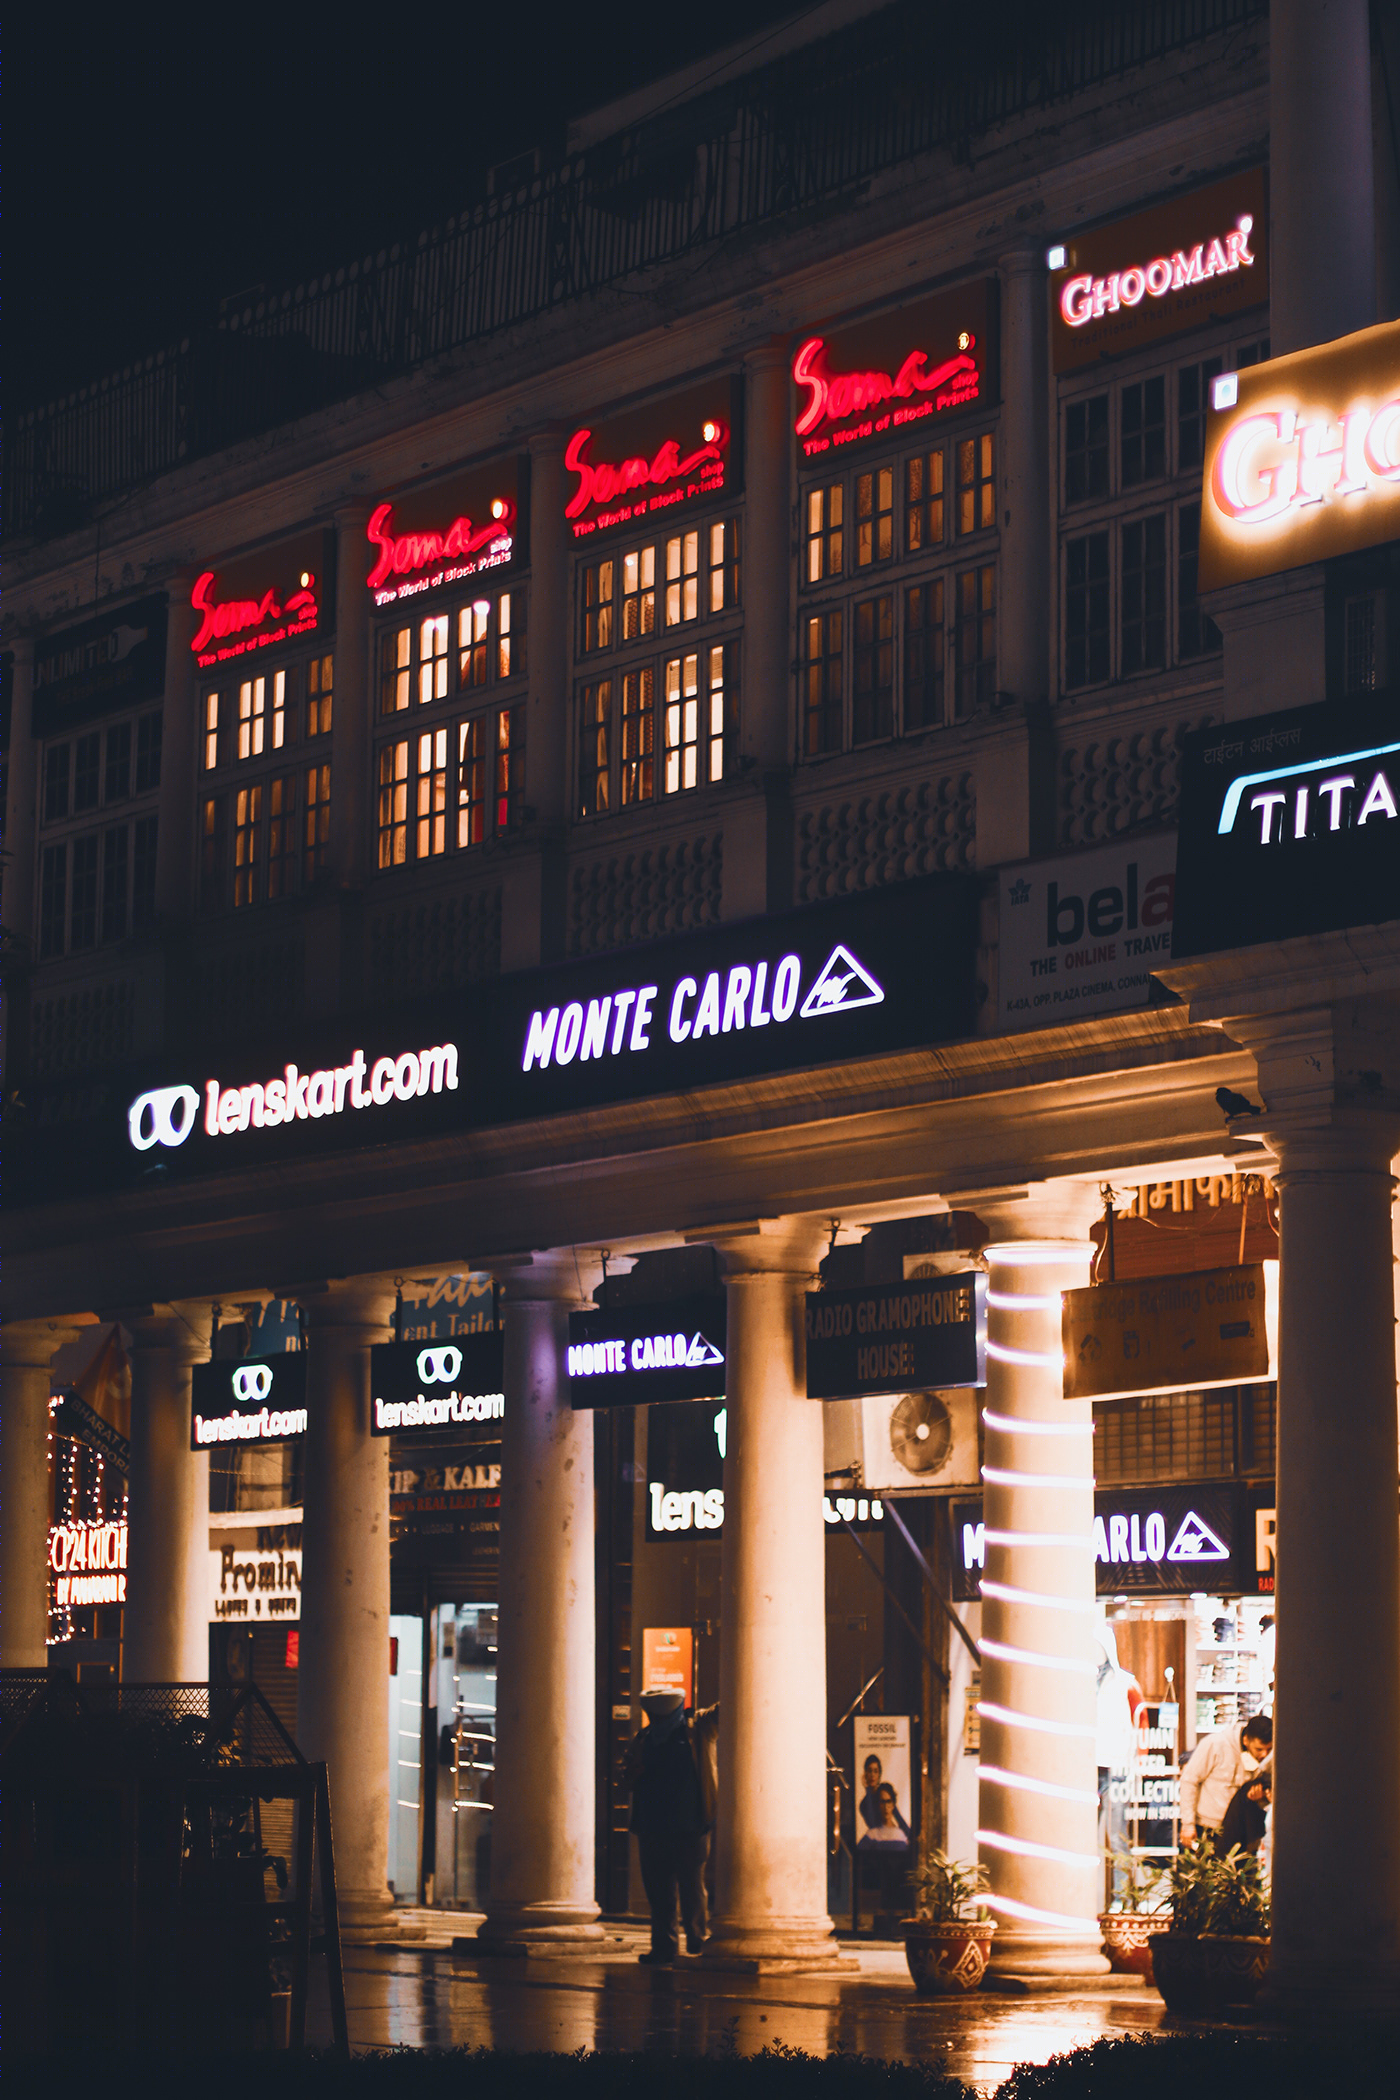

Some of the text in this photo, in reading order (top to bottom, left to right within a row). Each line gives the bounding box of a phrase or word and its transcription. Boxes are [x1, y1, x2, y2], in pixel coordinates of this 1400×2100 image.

[1060, 228, 1254, 327] GHOOMAR
[1071, 279, 1245, 349] Traditional Thali Restaurant
[803, 387, 979, 456] The World of Block Prints
[573, 476, 724, 538] The World of Block Prints
[375, 551, 511, 606] The World of Block Prints
[1250, 772, 1398, 845] TITA
[1030, 932, 1170, 977] THE ONLINE TRAVE
[522, 954, 800, 1072] MONTE CARLO
[1053, 988, 1080, 1003] PLAZA
[205, 1043, 458, 1136] lenskart.com
[806, 1288, 970, 1339] RADIO GRAMOPHONE
[1139, 1285, 1201, 1314] Refilling
[1206, 1279, 1255, 1305] Centre
[567, 1333, 687, 1377] MONTE CARLO
[71, 1399, 120, 1445] BHARAT
[195, 1407, 308, 1443] lenskart.com
[375, 1391, 505, 1429] lenskart.com
[416, 1497, 444, 1511] REAL
[868, 1723, 896, 1734] FOSSIL
